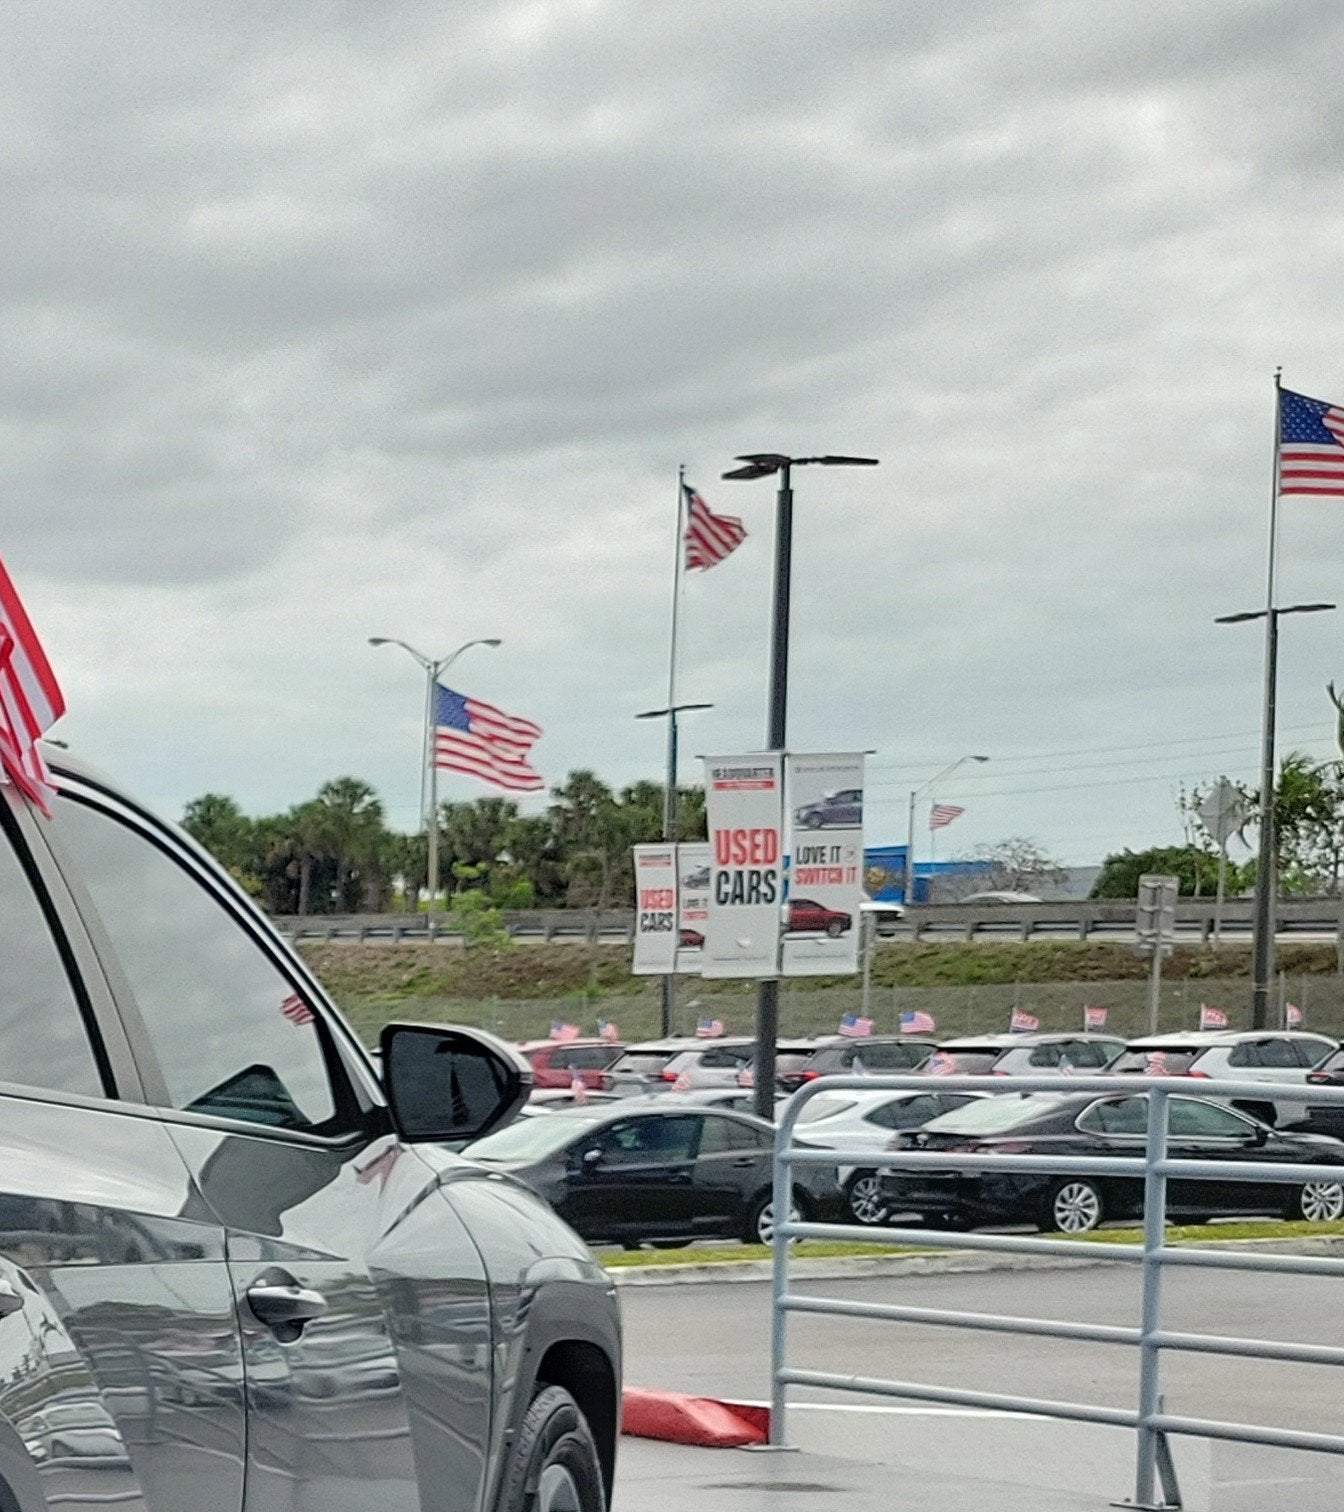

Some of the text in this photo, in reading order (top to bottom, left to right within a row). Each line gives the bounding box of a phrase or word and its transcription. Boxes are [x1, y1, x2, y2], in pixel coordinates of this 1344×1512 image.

[715, 828, 777, 867] USED
[796, 846, 841, 864] LOVE IT
[716, 869, 776, 906] CARS
